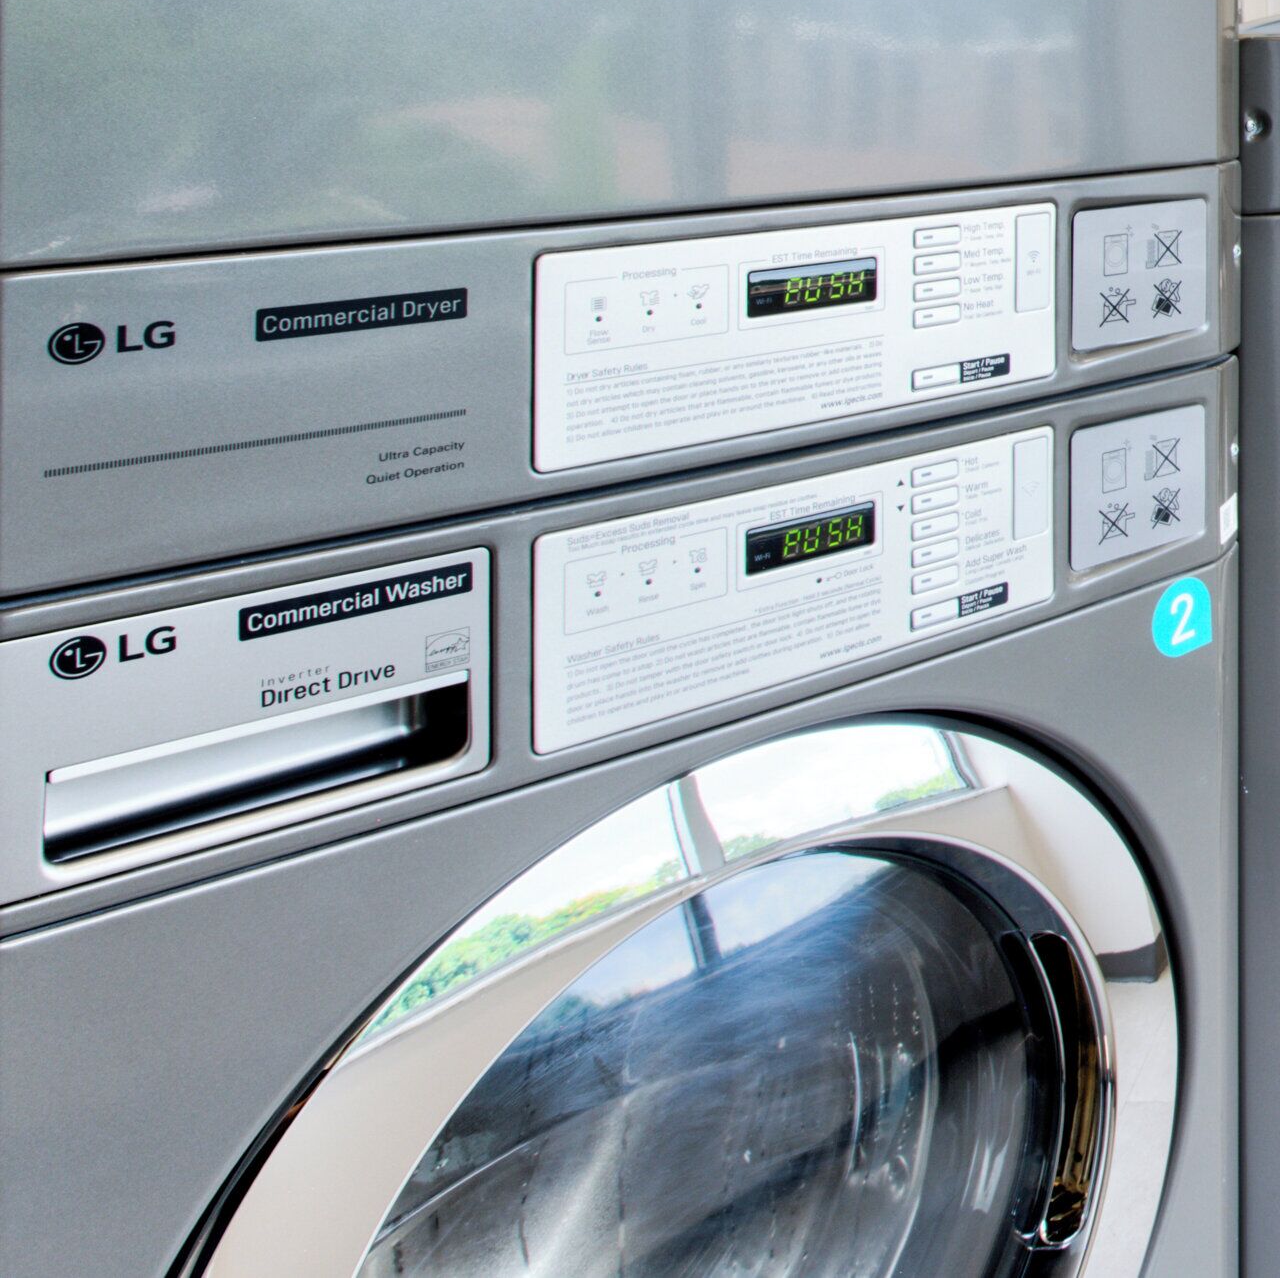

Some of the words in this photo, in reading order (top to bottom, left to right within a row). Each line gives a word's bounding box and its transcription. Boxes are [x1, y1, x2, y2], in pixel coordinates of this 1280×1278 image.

[963, 223, 981, 233] High
[771, 253, 788, 263] EST
[791, 252, 812, 260] Time
[814, 247, 858, 258] Remaining
[963, 249, 980, 258] Med
[622, 267, 677, 280] Processing
[963, 276, 980, 285] Low
[785, 269, 864, 304] PUSH
[963, 302, 974, 310] No
[975, 299, 994, 308] Heat
[116, 319, 176, 353] LG
[262, 302, 395, 335] Commercial
[403, 296, 462, 323] Dryer
[641, 325, 655, 333] Dry
[690, 317, 707, 326] Cool
[586, 336, 611, 345] Sense
[589, 329, 608, 337] Flow
[962, 359, 979, 370] Start
[985, 355, 1005, 366] Pause
[566, 372, 589, 381] Dryer
[591, 367, 621, 377] Safety
[623, 363, 648, 372] Rules
[378, 448, 409, 463] Ultra
[413, 439, 465, 461] Capacity
[365, 470, 400, 486] Quiet
[403, 461, 465, 482] Operation
[769, 508, 787, 521] EST
[789, 505, 810, 515] Time
[812, 494, 855, 510] Remaining
[628, 520, 651, 532] Suds
[652, 512, 689, 526] Removal
[783, 512, 862, 558] PUSH
[964, 529, 999, 544] Delicates
[620, 535, 675, 553] Processing
[964, 557, 981, 568] Add
[982, 551, 1004, 563] Super
[1006, 544, 1026, 556] Wash
[843, 568, 858, 577] Door
[858, 563, 874, 572] Lock
[689, 581, 706, 591] Spin
[961, 591, 978, 604] Start
[983, 584, 1003, 597] Pause
[638, 593, 659, 603] Rinse
[119, 625, 177, 663] LG
[247, 589, 380, 633] Commercial
[385, 571, 467, 603] Washer
[586, 605, 609, 616] Wash
[1170, 592, 1196, 646] 2
[566, 648, 602, 663] Washer
[604, 641, 634, 654] Safety
[635, 634, 660, 645] Rules
[260, 664, 331, 688] Inverter
[260, 677, 332, 708] Direct
[338, 662, 396, 690] Drive
